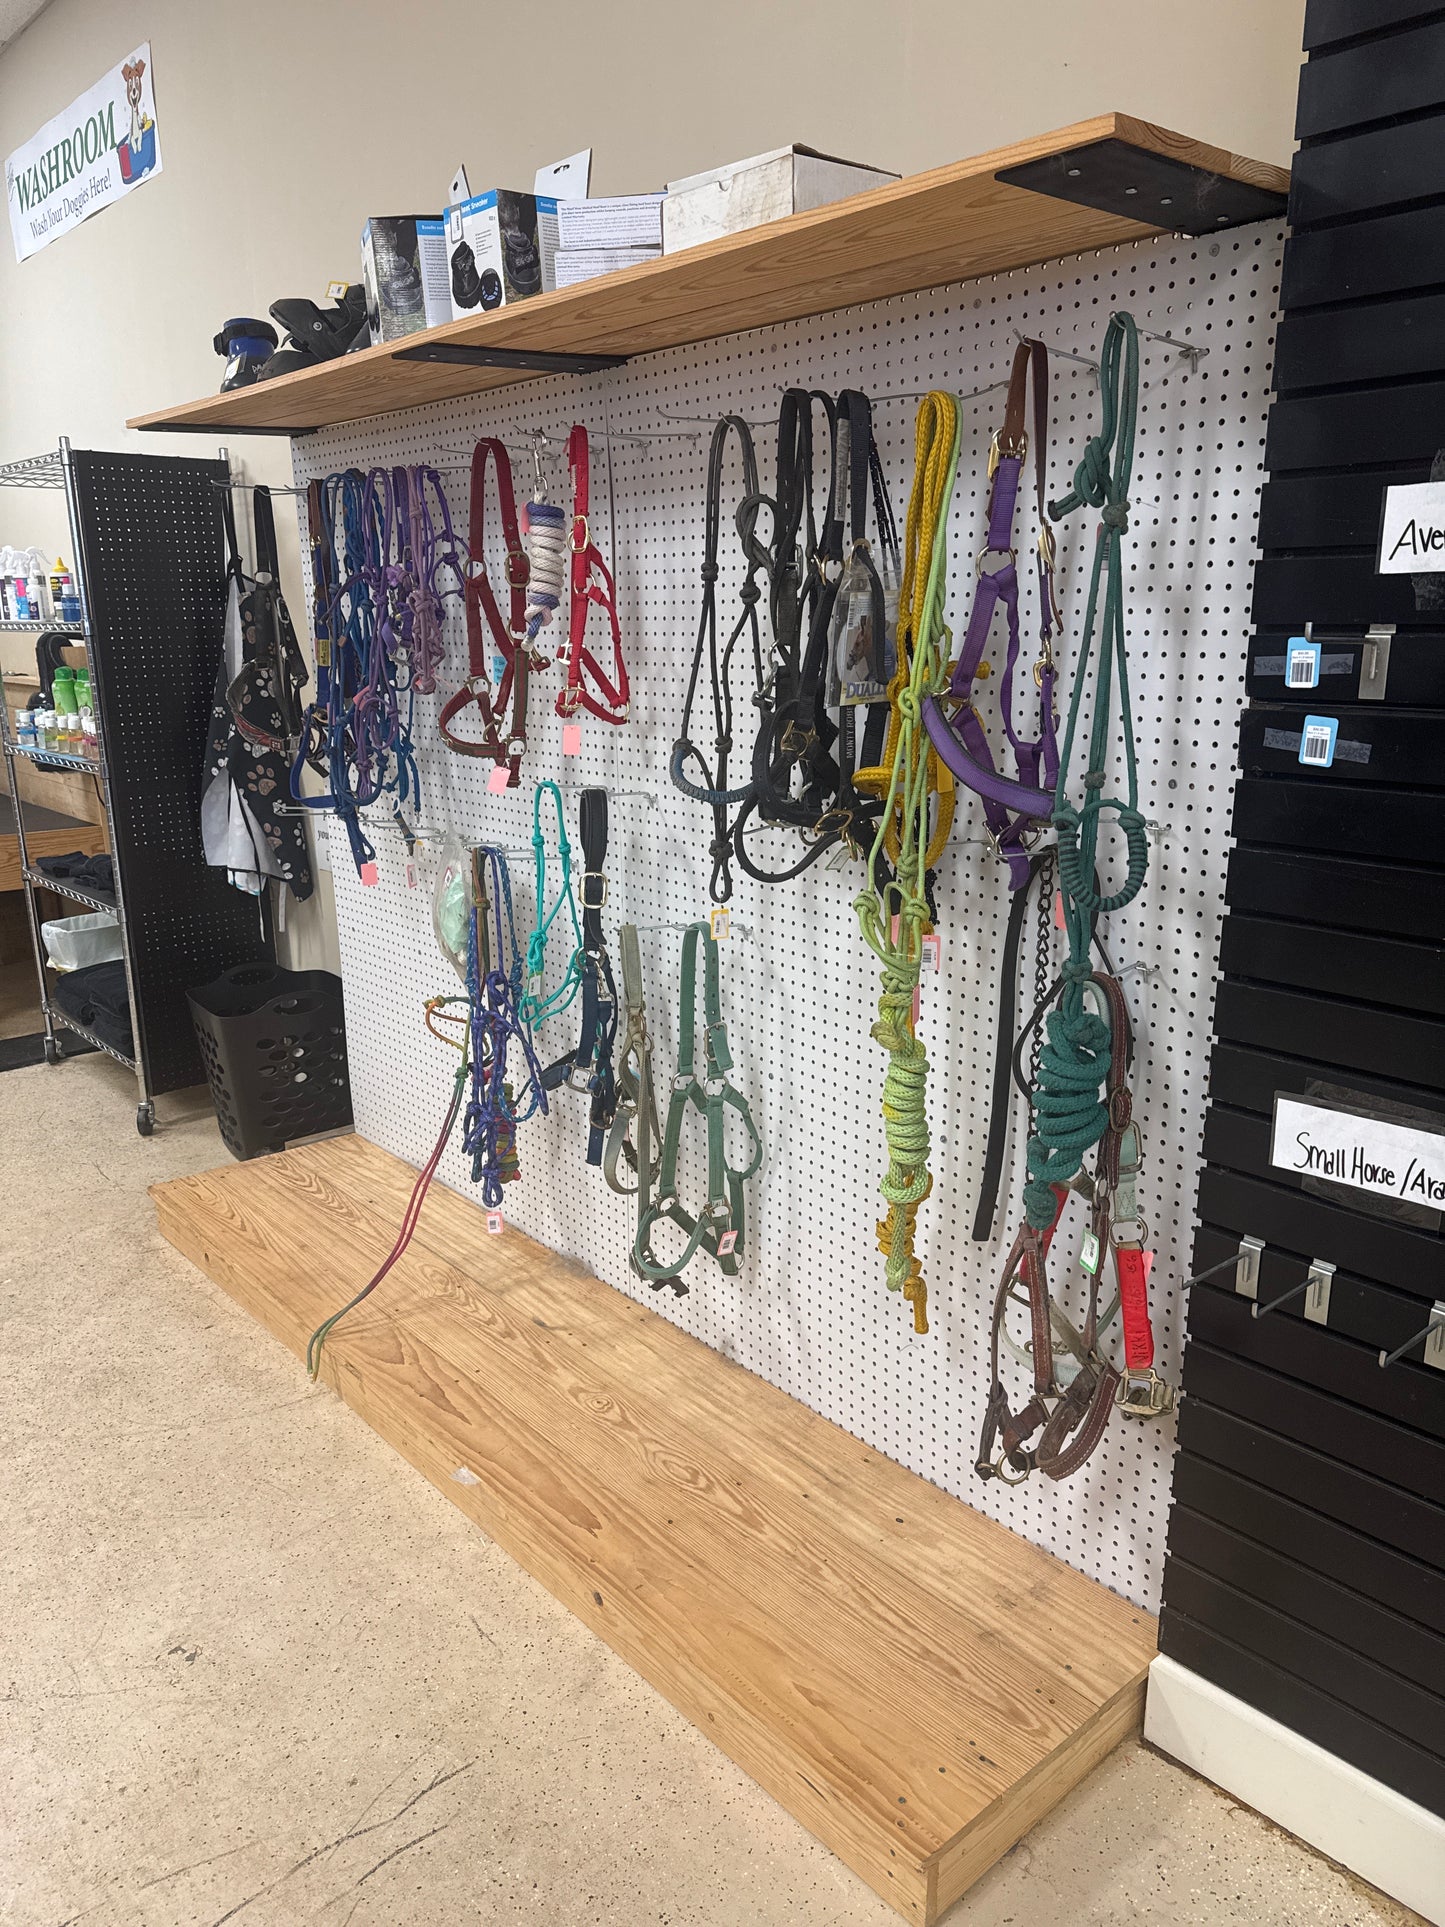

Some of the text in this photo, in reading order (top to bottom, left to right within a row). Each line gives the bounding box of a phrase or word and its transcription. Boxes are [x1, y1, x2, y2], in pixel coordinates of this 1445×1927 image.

[15, 101, 118, 215] WASHROOM
[30, 168, 111, 239] Wash Your Doggies Here!
[1388, 518, 1445, 561] Ave
[846, 730, 854, 759] MONTY
[1293, 1131, 1345, 1178] Small
